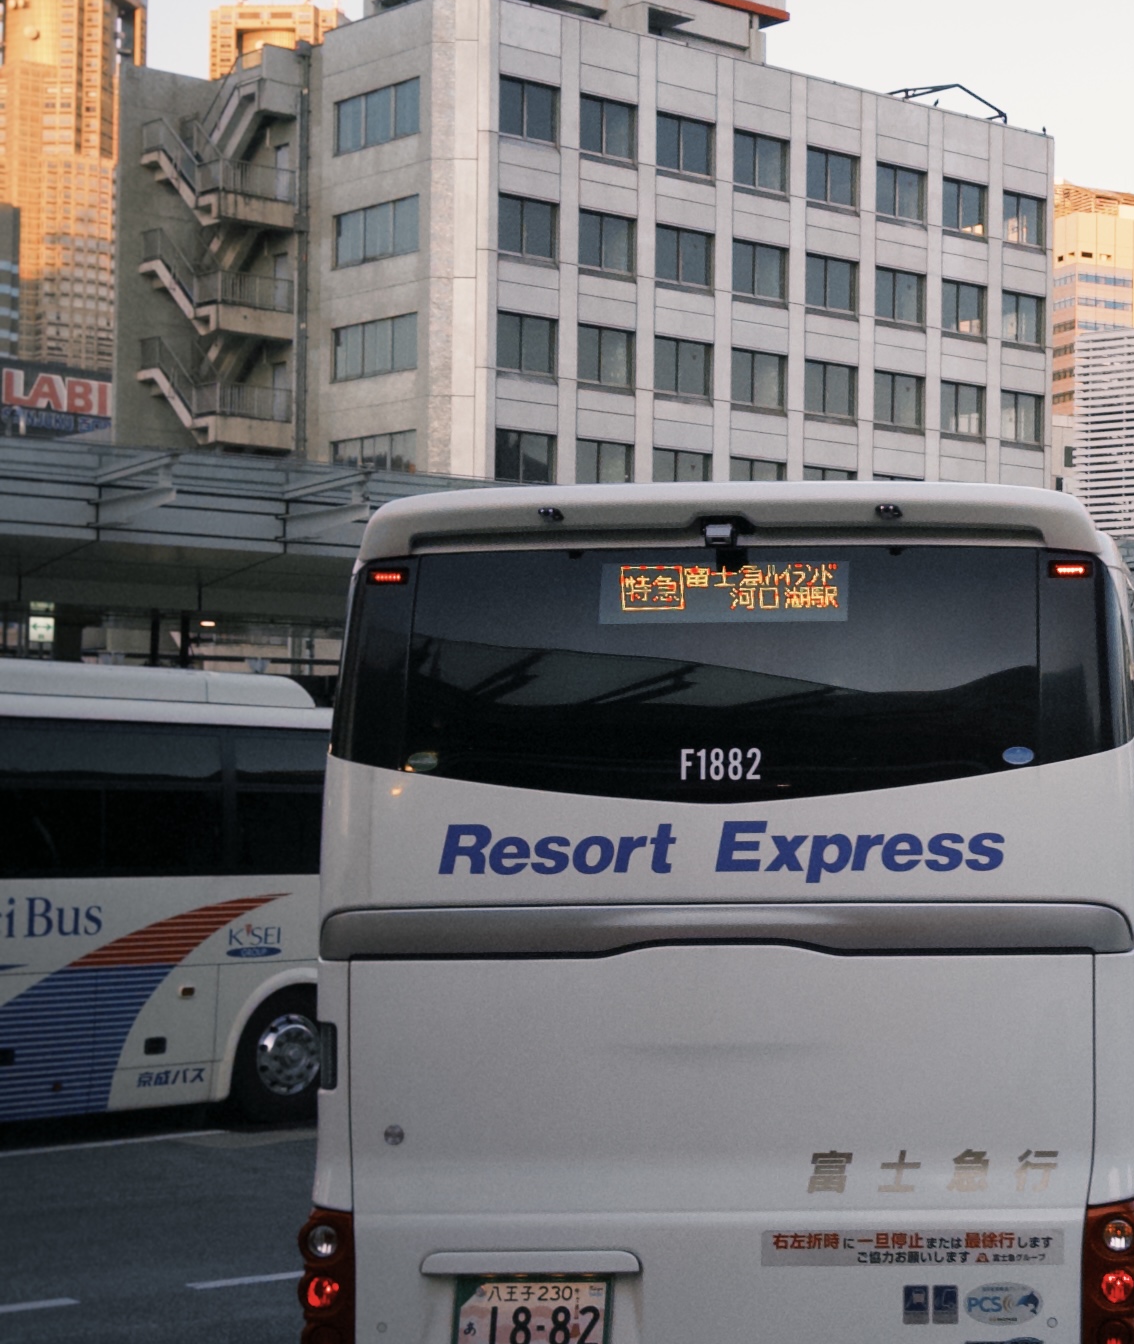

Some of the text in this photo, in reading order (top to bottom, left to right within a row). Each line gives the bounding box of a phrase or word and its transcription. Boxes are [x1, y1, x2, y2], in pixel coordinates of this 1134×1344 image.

[3, 368, 111, 416] LABI
[624, 574, 681, 602] 特急
[729, 586, 839, 609] 河口湖駅
[680, 748, 762, 780] F1882
[438, 821, 1005, 883] Resort Express
[137, 1068, 206, 1088] 京成バス
[807, 1149, 1059, 1194] 富士急行
[487, 1286, 535, 1302] 八王子
[538, 1285, 573, 1301] 230
[967, 1297, 1003, 1313] PCS
[463, 1321, 477, 1336] あ
